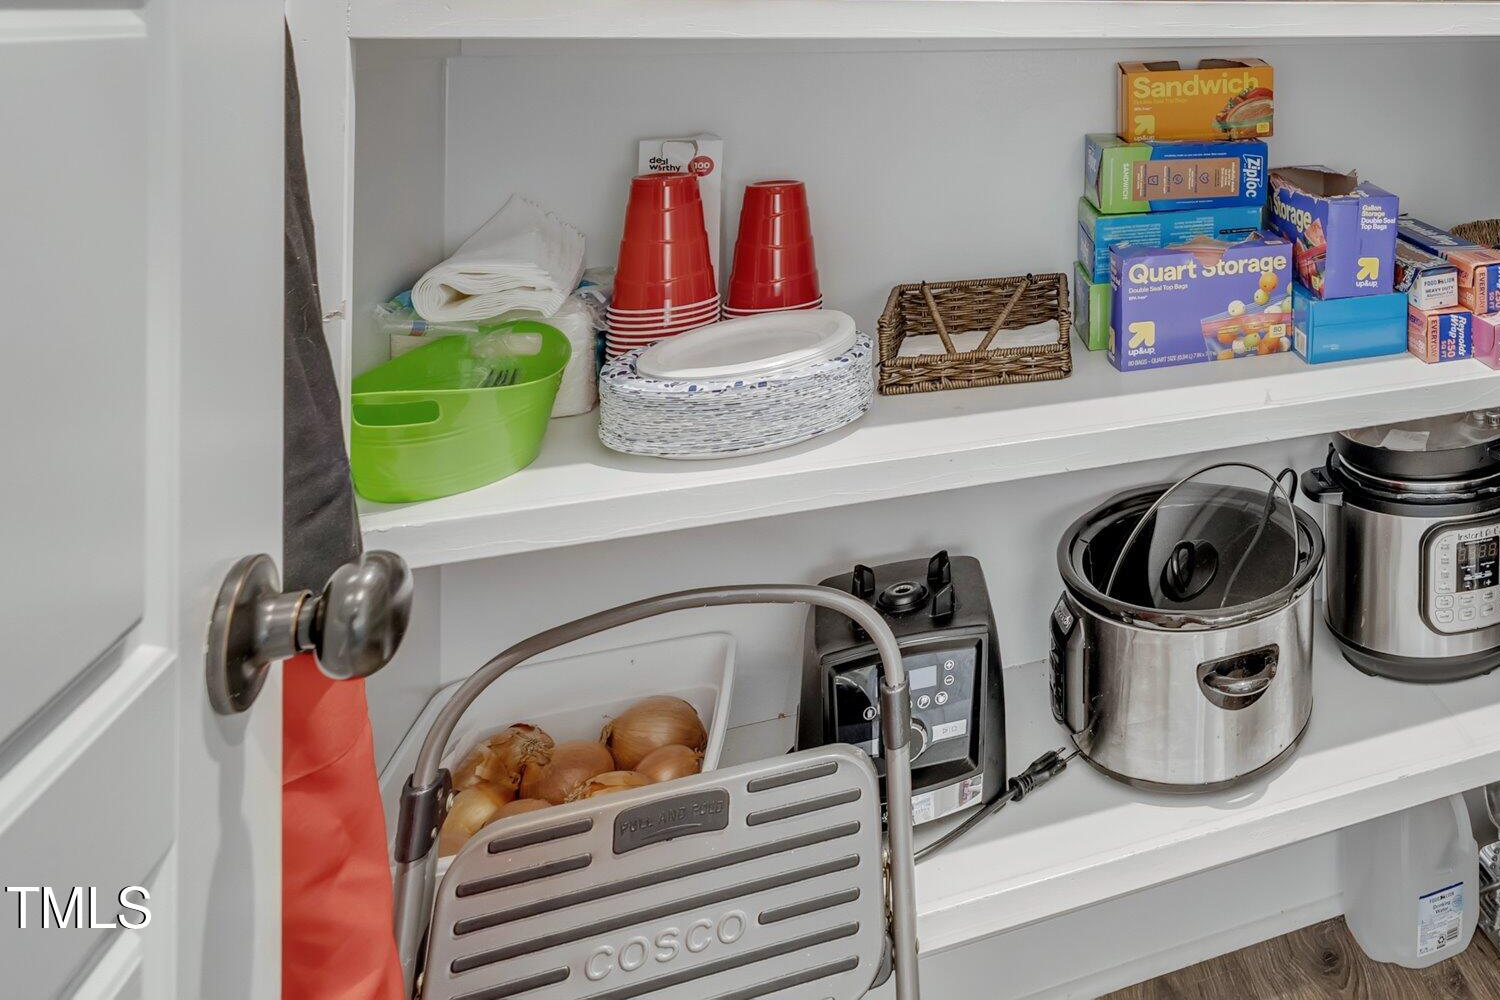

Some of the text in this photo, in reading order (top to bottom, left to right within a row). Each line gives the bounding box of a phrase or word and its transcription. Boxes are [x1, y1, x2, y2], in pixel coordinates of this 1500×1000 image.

[1133, 72, 1259, 99] Sandwich
[649, 157, 669, 165] deal
[1245, 157, 1261, 198] Ziploc
[1128, 255, 1287, 284] Quart Storage
[1128, 286, 1149, 294] Double
[1163, 284, 1174, 292] Top
[1174, 283, 1188, 291] Bags
[1447, 314, 1457, 358] Wrap 250
[1458, 316, 1467, 356] Reynolds
[1128, 348, 1155, 356] up&up
[1457, 530, 1483, 541] Instant
[619, 799, 724, 837] PULL AND FOLD
[1432, 900, 1451, 910] Drinking
[585, 909, 747, 982] COSCO
